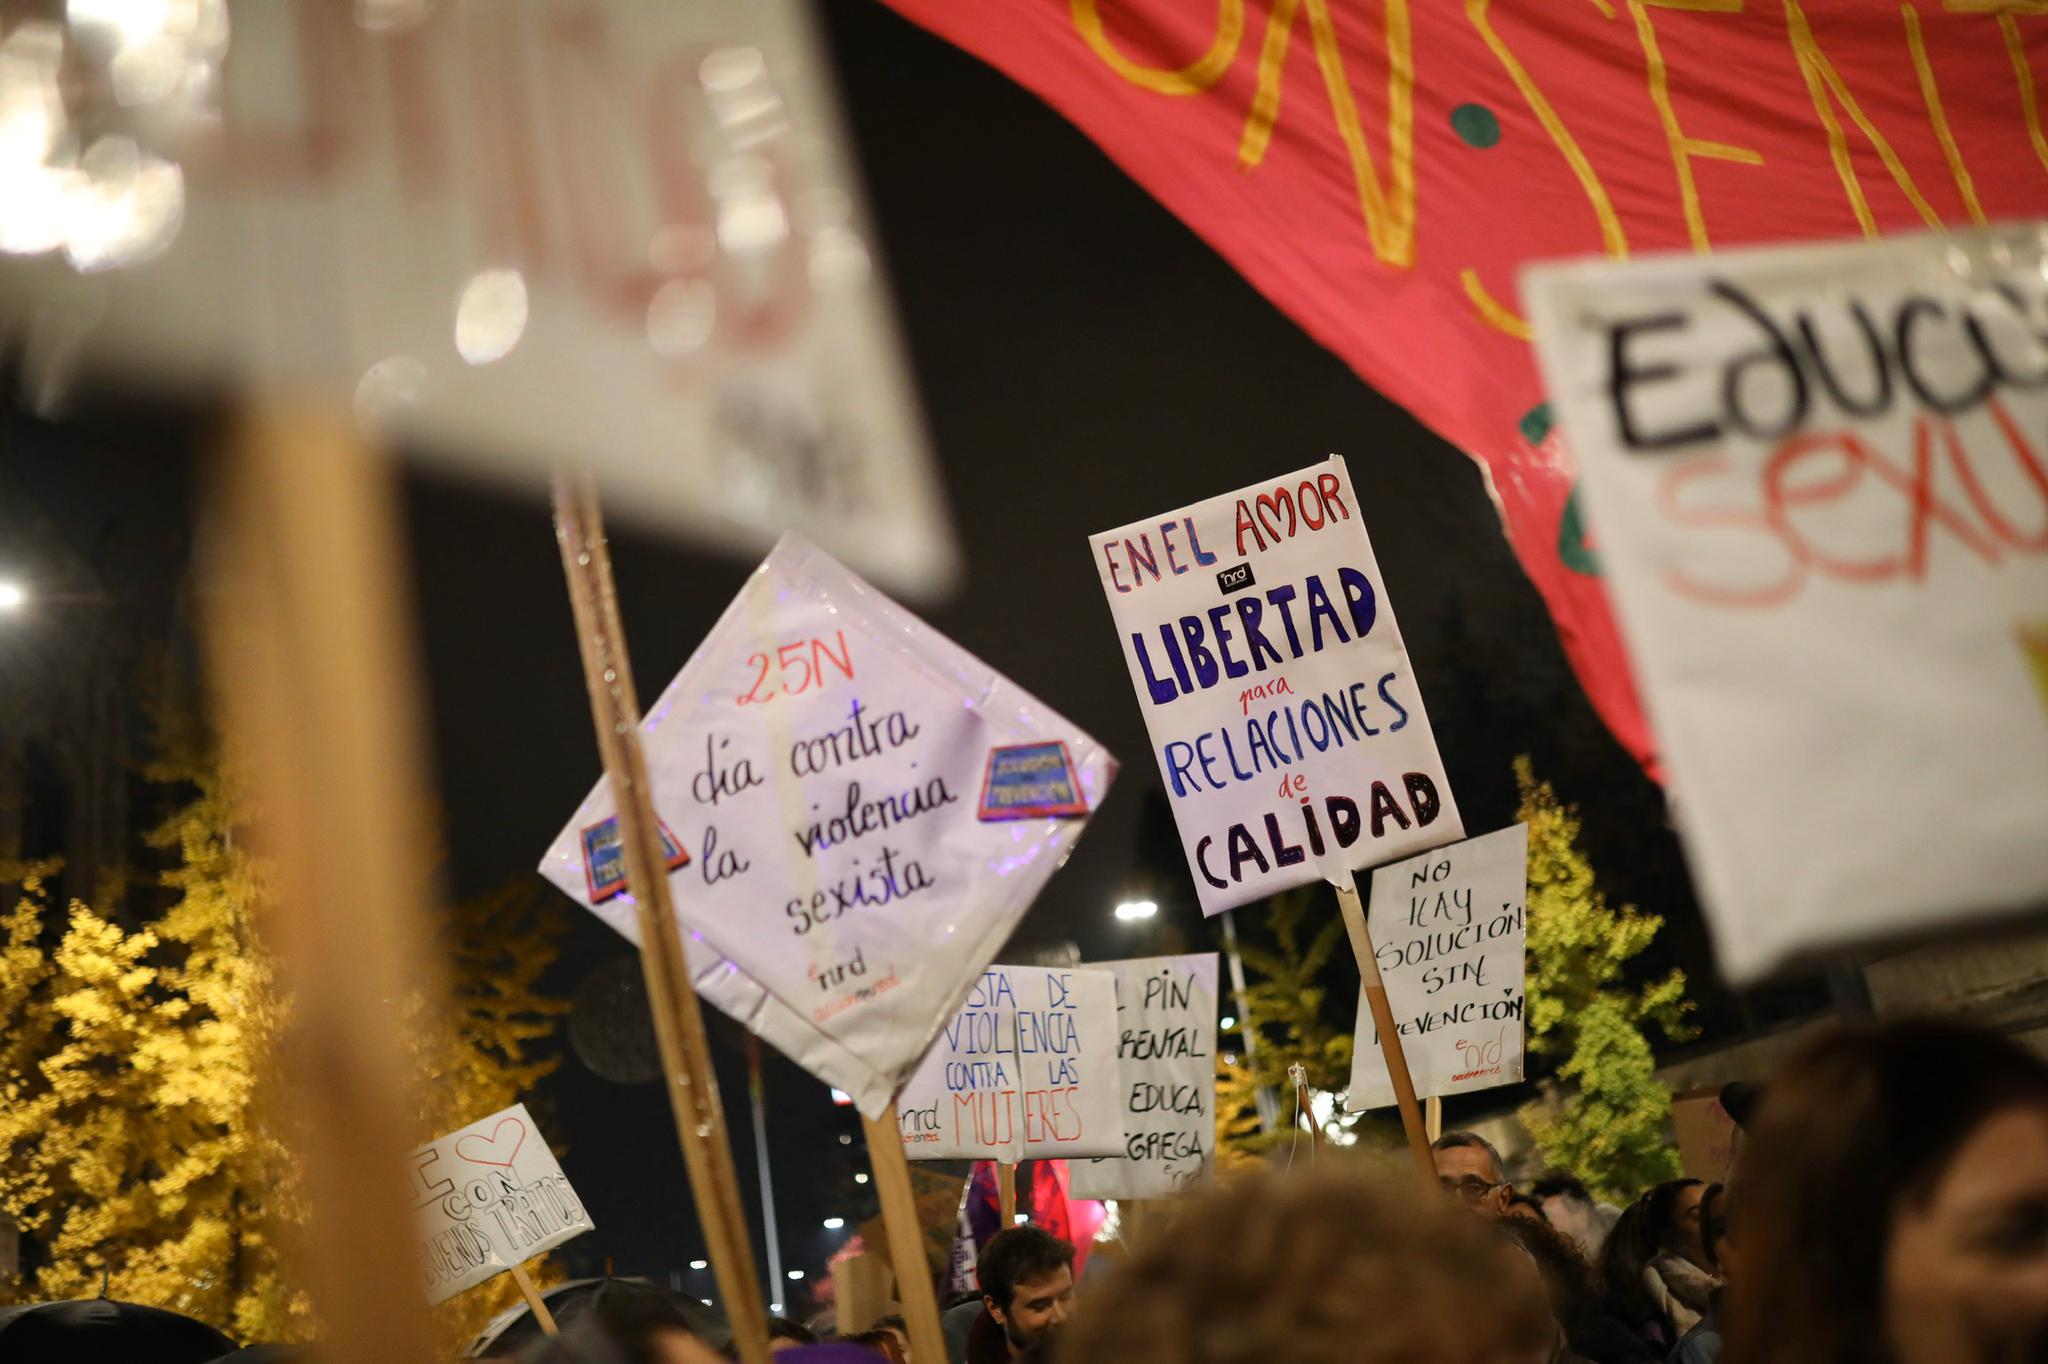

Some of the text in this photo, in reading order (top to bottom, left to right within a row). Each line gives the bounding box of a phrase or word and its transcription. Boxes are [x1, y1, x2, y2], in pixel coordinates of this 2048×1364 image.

[1103, 473, 1350, 593] EN EL AMOR
[1131, 567, 1377, 705] LIBERTAD
[736, 630, 854, 706] 25N
[1238, 675, 1294, 716] para
[790, 699, 920, 778] contra
[1164, 672, 1409, 798] RELACIONES
[1278, 772, 1308, 799] de
[702, 761, 958, 885] la violencia
[785, 846, 934, 936] sexista
[1411, 860, 1451, 889] NO
[1047, 973, 1077, 1009] DE
[1422, 954, 1489, 995] SIN
[945, 1011, 1081, 1055] VIOLENCIA
[1375, 988, 1523, 1045] EVENCIÓN
[945, 1058, 1079, 1091] CONTRA LAS
[953, 1087, 1082, 1147] MUJERES
[1124, 1130, 1204, 1163] GREGA
[442, 1166, 523, 1222] CON
[483, 1172, 585, 1250] TRATOS
